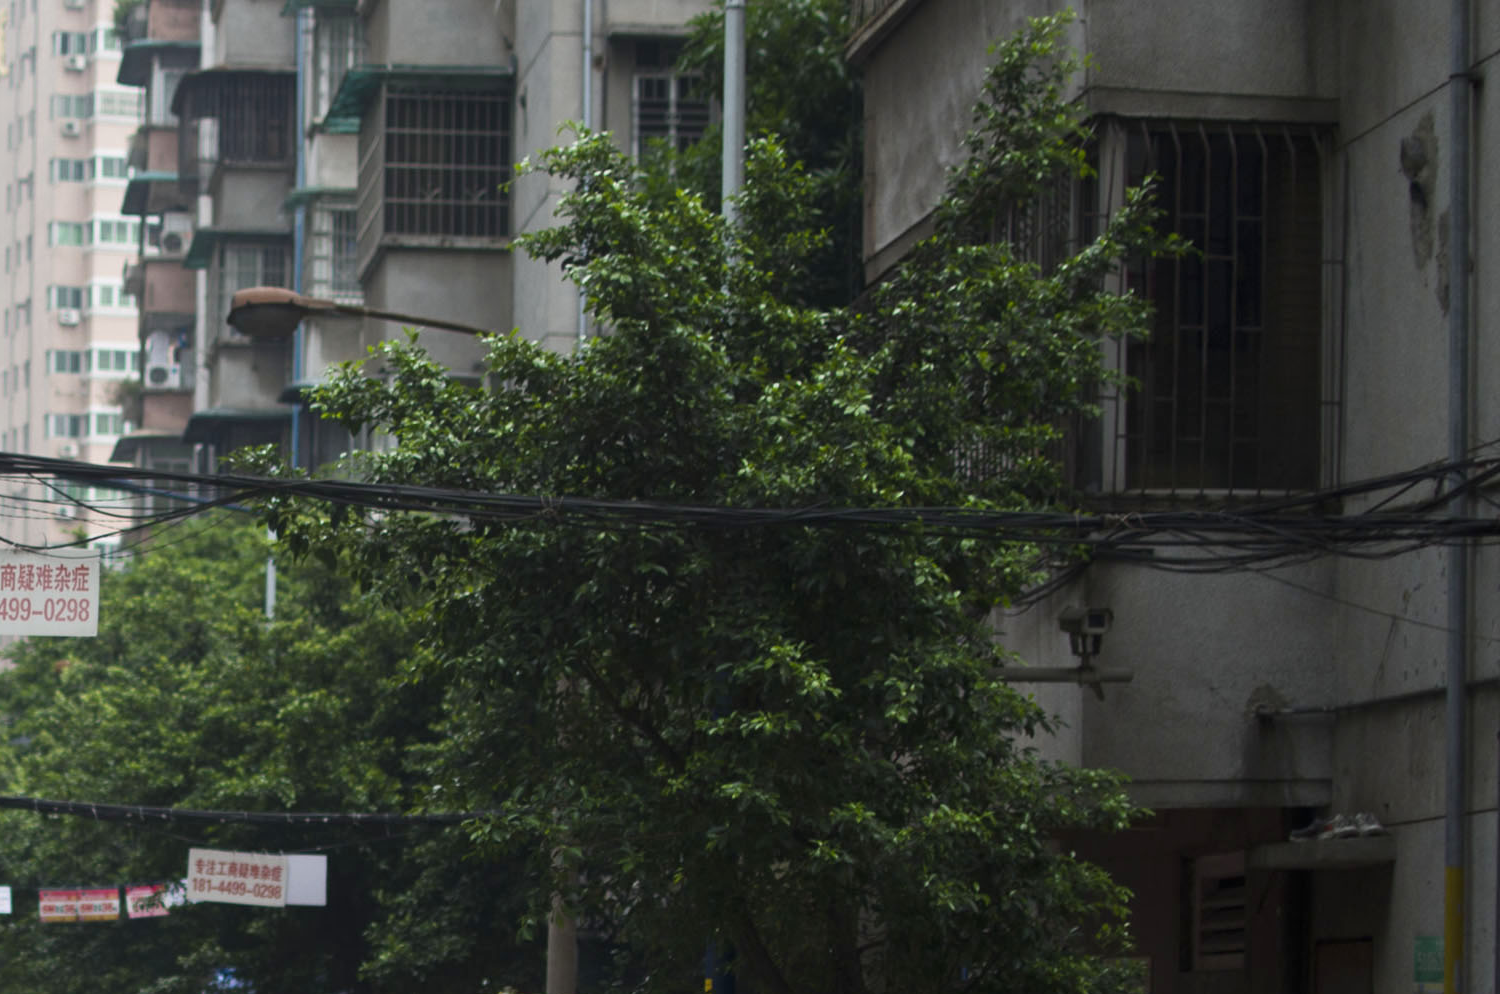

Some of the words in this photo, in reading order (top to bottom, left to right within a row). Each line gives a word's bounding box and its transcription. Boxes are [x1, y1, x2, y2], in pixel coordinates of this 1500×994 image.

[196, 858, 284, 882] 专注工商疑难杂症
[192, 877, 282, 900] 181-4499-0298
